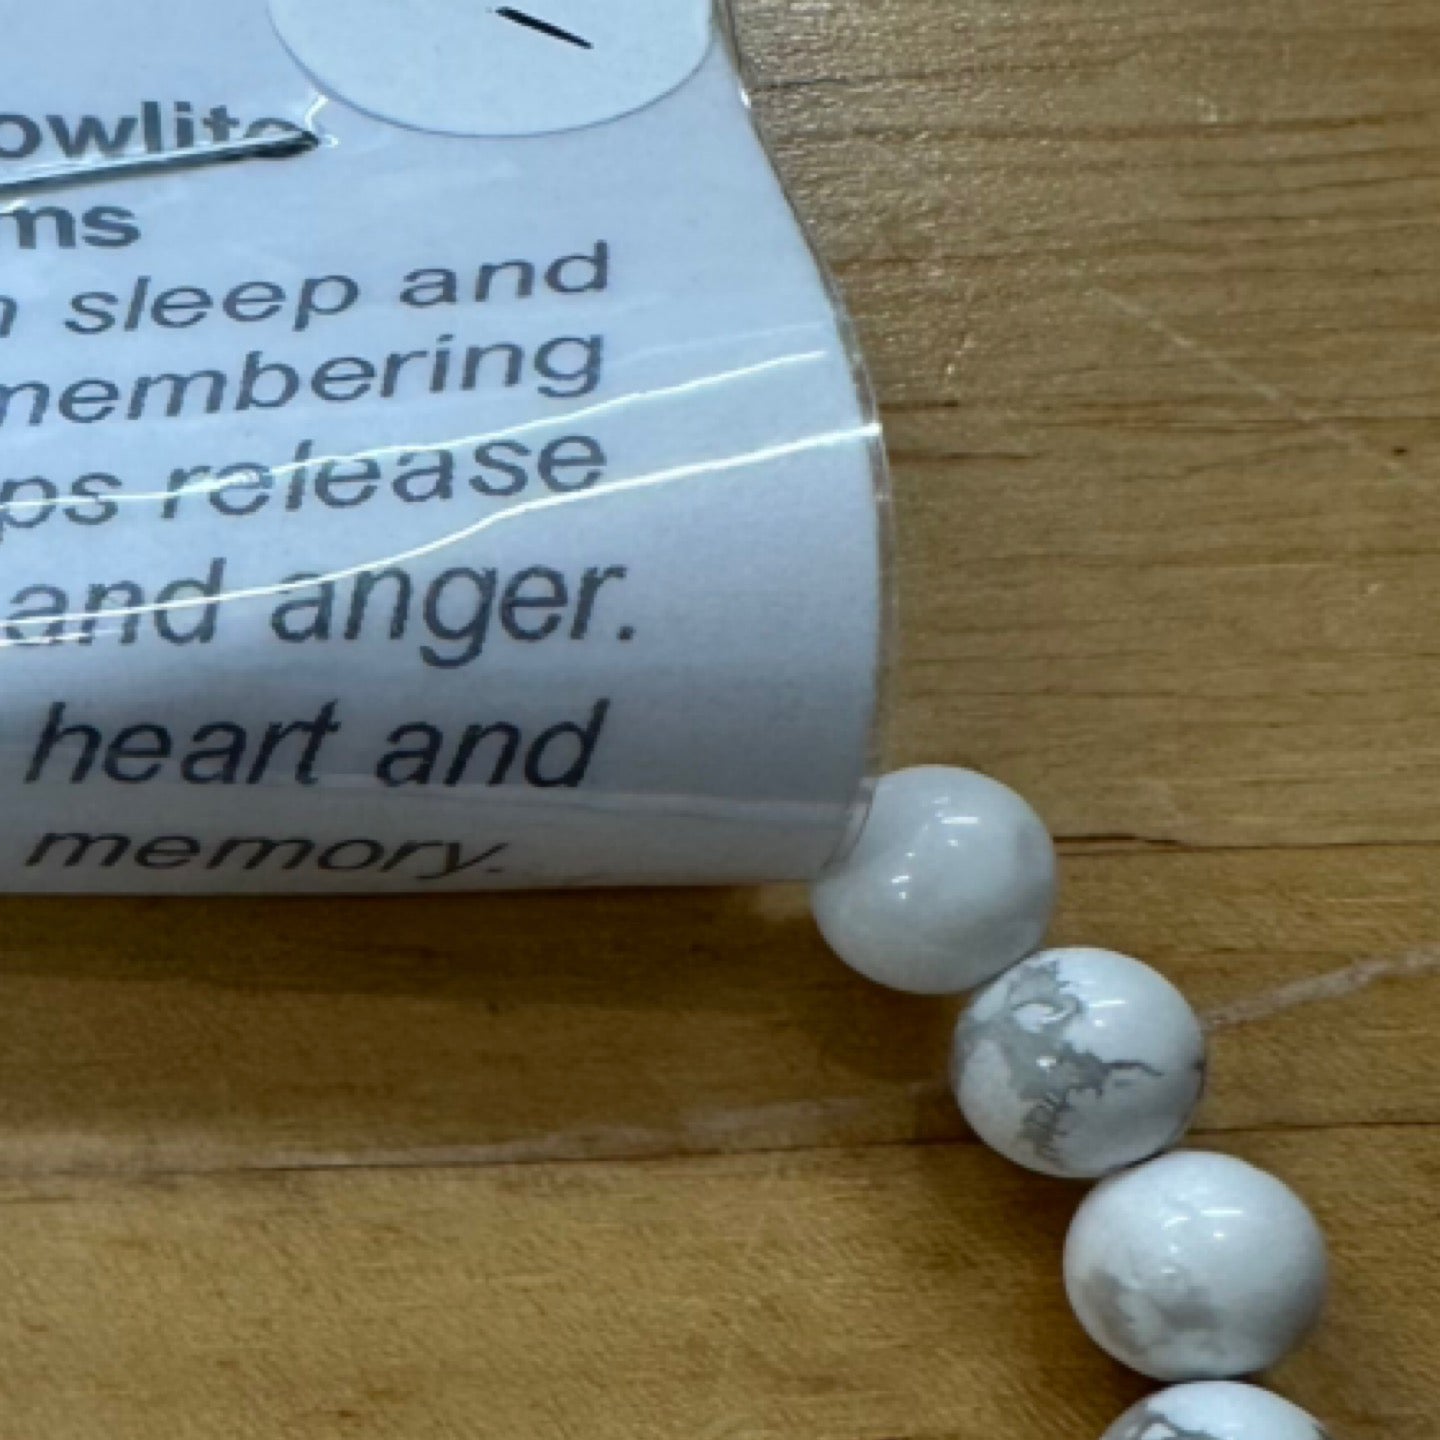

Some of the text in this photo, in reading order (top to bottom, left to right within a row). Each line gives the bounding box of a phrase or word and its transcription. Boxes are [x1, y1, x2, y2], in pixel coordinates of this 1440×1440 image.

[63, 275, 360, 332] sleep
[398, 240, 612, 307] and
[161, 433, 608, 518] release
[4, 558, 228, 646] and
[267, 563, 638, 668] anger.
[23, 701, 340, 784] heart
[374, 697, 612, 788] and
[22, 828, 508, 880] memory.
